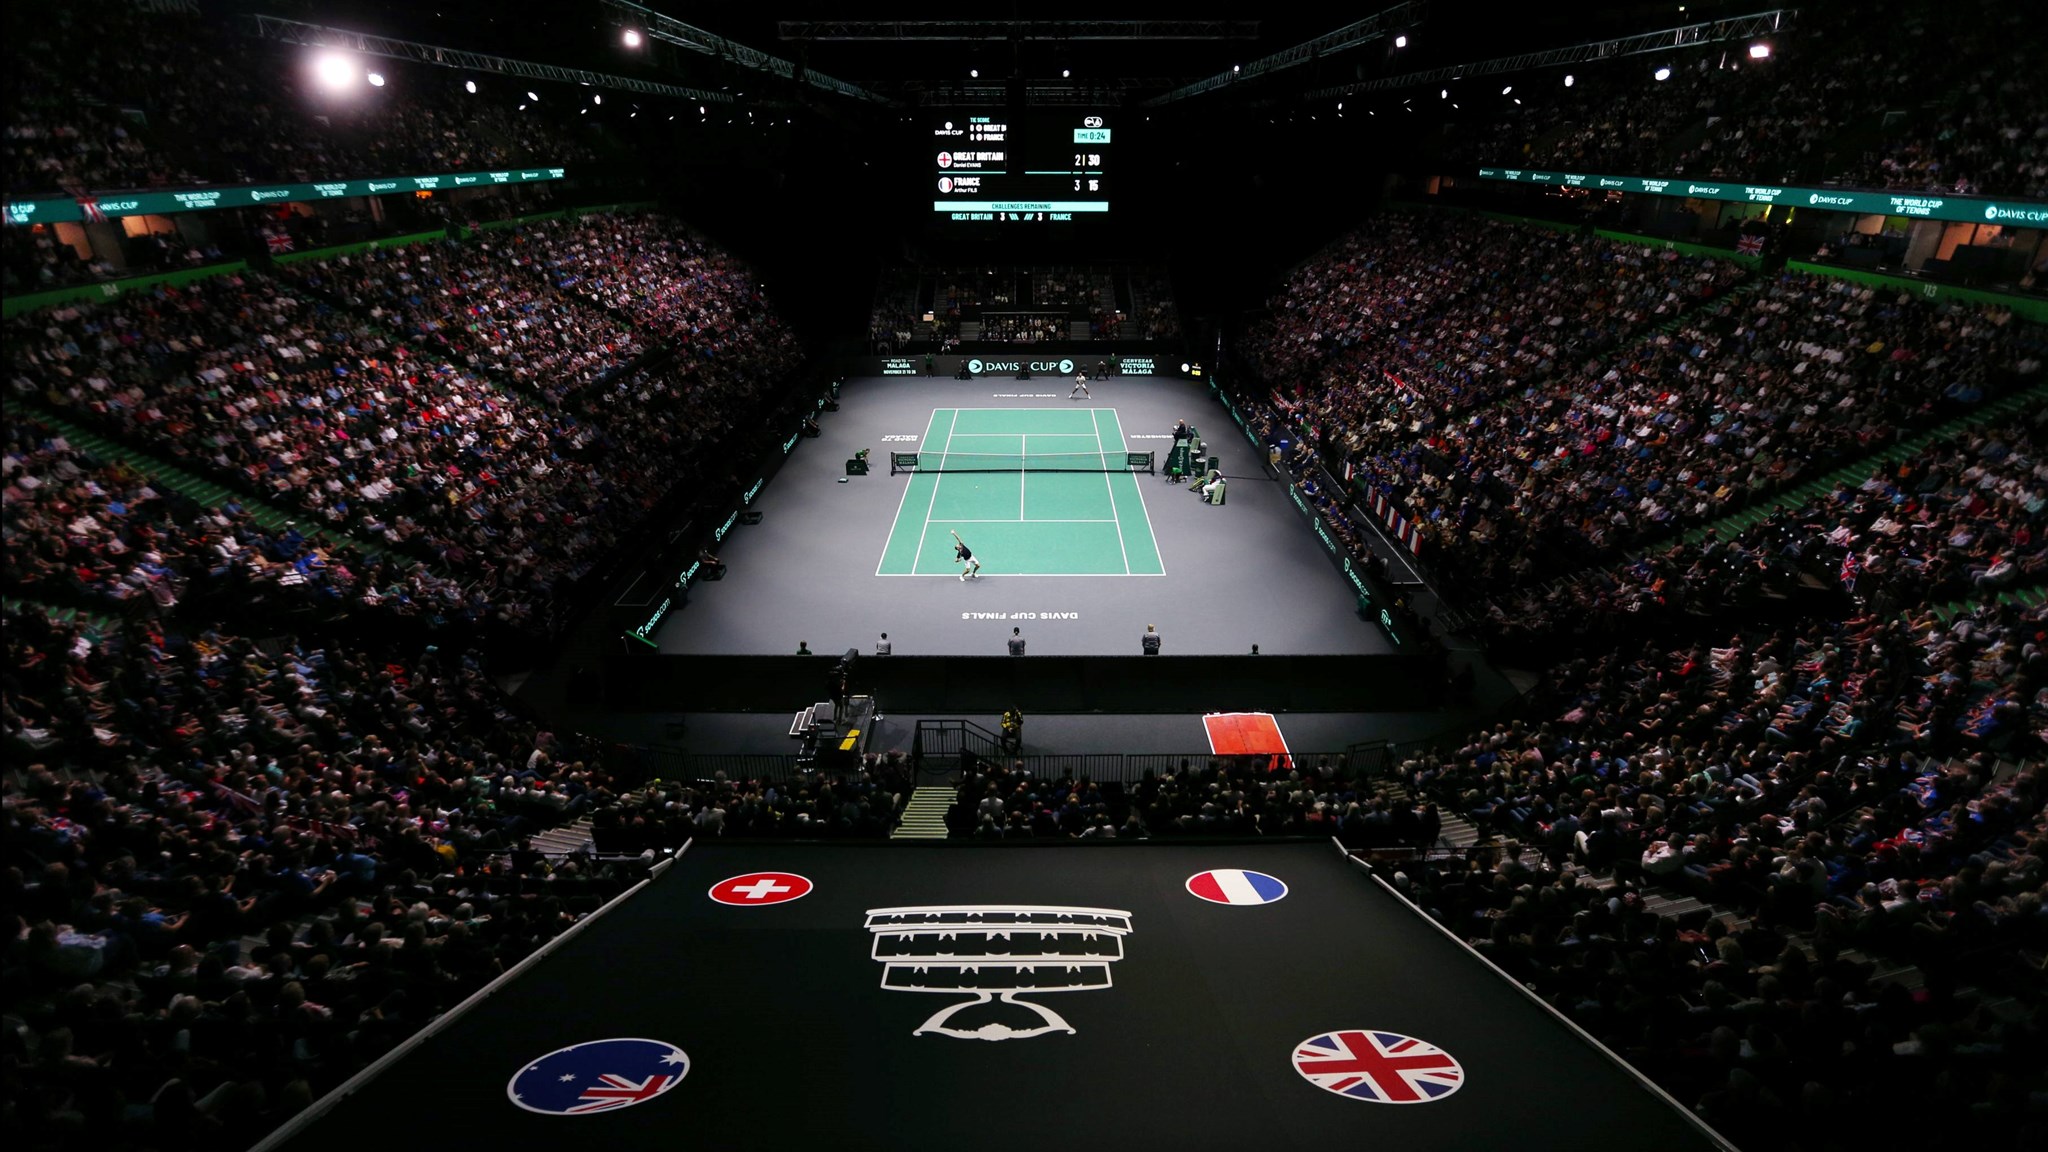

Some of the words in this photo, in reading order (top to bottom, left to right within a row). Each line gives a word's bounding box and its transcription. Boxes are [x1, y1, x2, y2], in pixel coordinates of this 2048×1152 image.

[983, 133, 1004, 141] FRANCE
[1089, 132, 1106, 140] 0:24
[953, 152, 975, 161] GREAT
[976, 152, 1004, 161] BRITAIN
[1075, 154, 1081, 166] 2
[1088, 154, 1100, 166] 30
[954, 177, 980, 186] FRANCE
[1074, 179, 1080, 191] 3
[1088, 179, 1099, 191] 15
[278, 190, 290, 198] CUP
[120, 201, 138, 210] CUP
[1904, 198, 1927, 208] WORLD
[1928, 200, 1943, 208] CUP
[1906, 206, 1931, 215] TENNIS
[1998, 209, 2026, 219] DAVIS
[2027, 211, 2048, 221] CUP
[951, 213, 969, 221] GREAT
[971, 213, 993, 221] BRITAIN
[1000, 212, 1005, 221] 3
[1037, 212, 1043, 221] 3
[1050, 213, 1072, 221] FRANCE
[986, 362, 1020, 371] DAVIS
[1030, 362, 1057, 371] CUP
[961, 612, 1006, 620] FINALS
[1010, 612, 1036, 620] CUP
[1040, 612, 1078, 620] DAVIS
